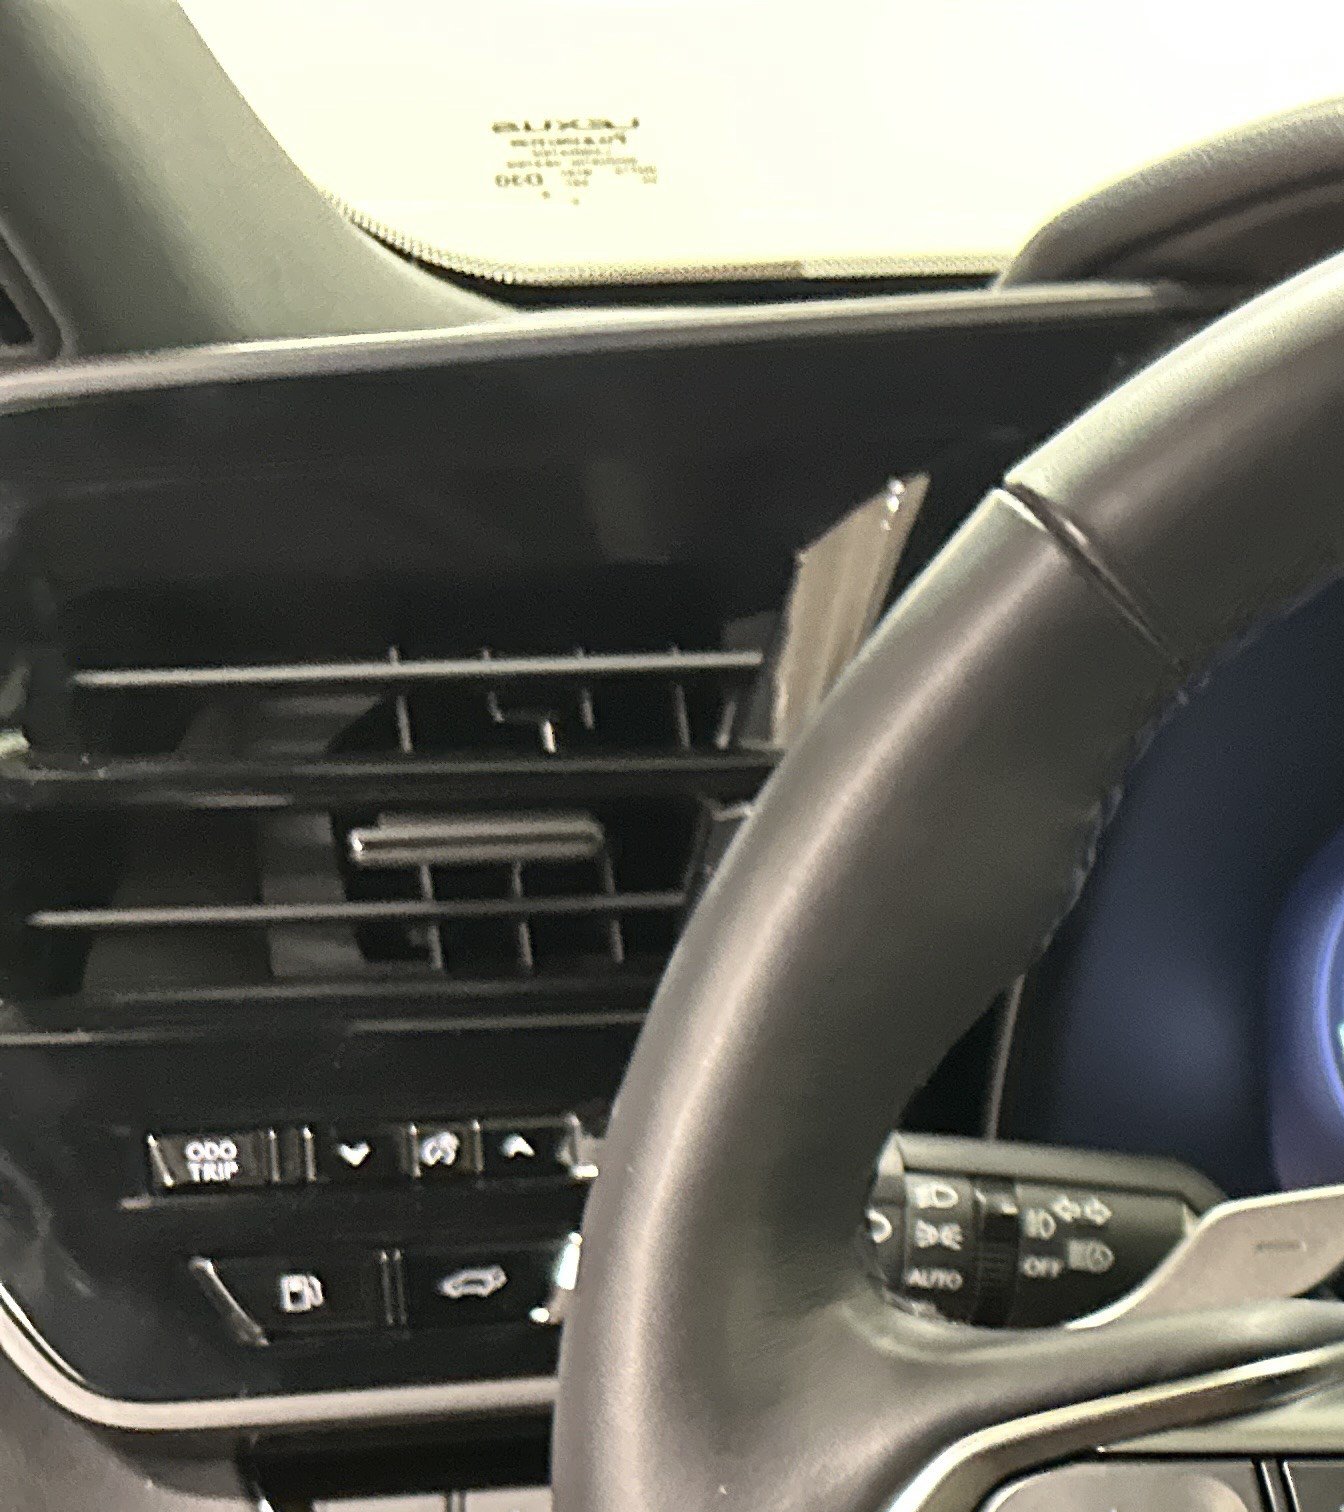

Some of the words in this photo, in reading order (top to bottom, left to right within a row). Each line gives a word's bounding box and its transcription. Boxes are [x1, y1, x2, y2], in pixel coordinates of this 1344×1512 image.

[185, 1139, 239, 1161] ODO
[187, 1160, 240, 1182] TRIP
[1020, 1255, 1062, 1278] OFF
[907, 1265, 963, 1292] AUTO
